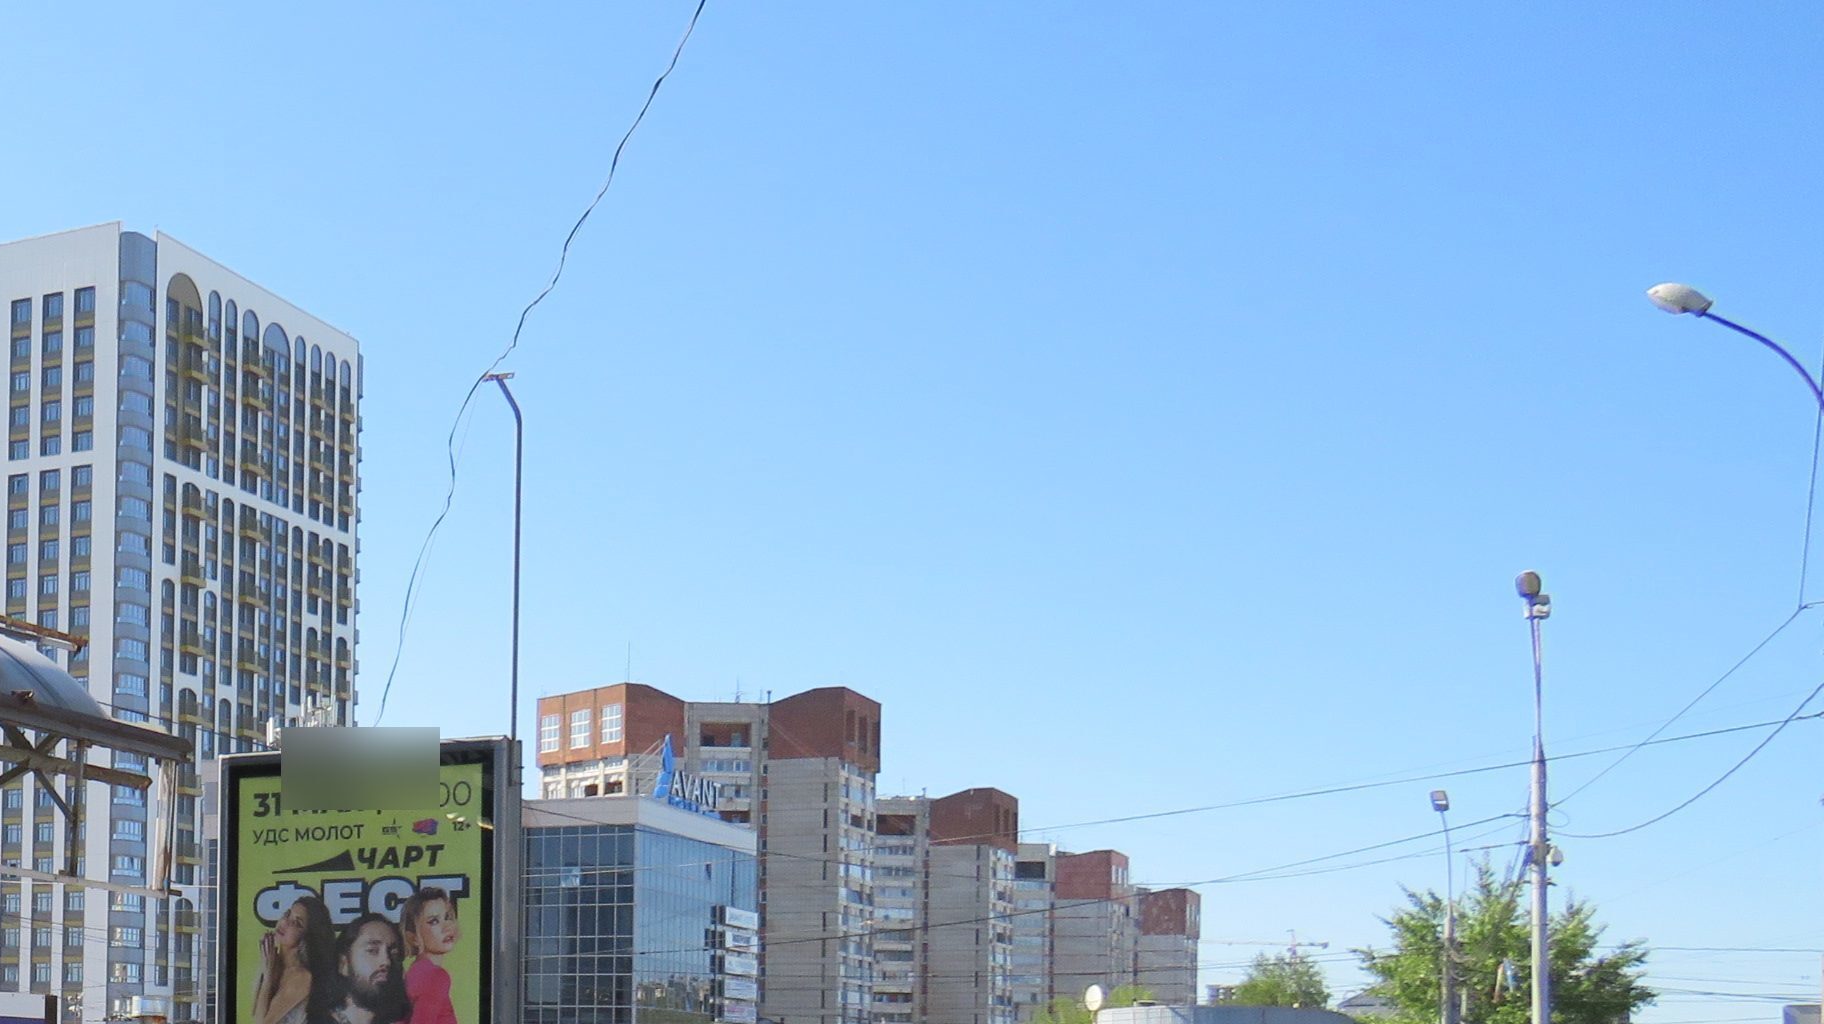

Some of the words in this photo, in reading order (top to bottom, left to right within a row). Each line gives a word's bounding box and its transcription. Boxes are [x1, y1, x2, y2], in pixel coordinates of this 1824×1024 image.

[669, 770, 721, 809] AVANT
[253, 829, 289, 846] УДС
[295, 824, 364, 842] МОЛОТ
[452, 821, 471, 832] 12+
[357, 844, 445, 870] ЧАРТ
